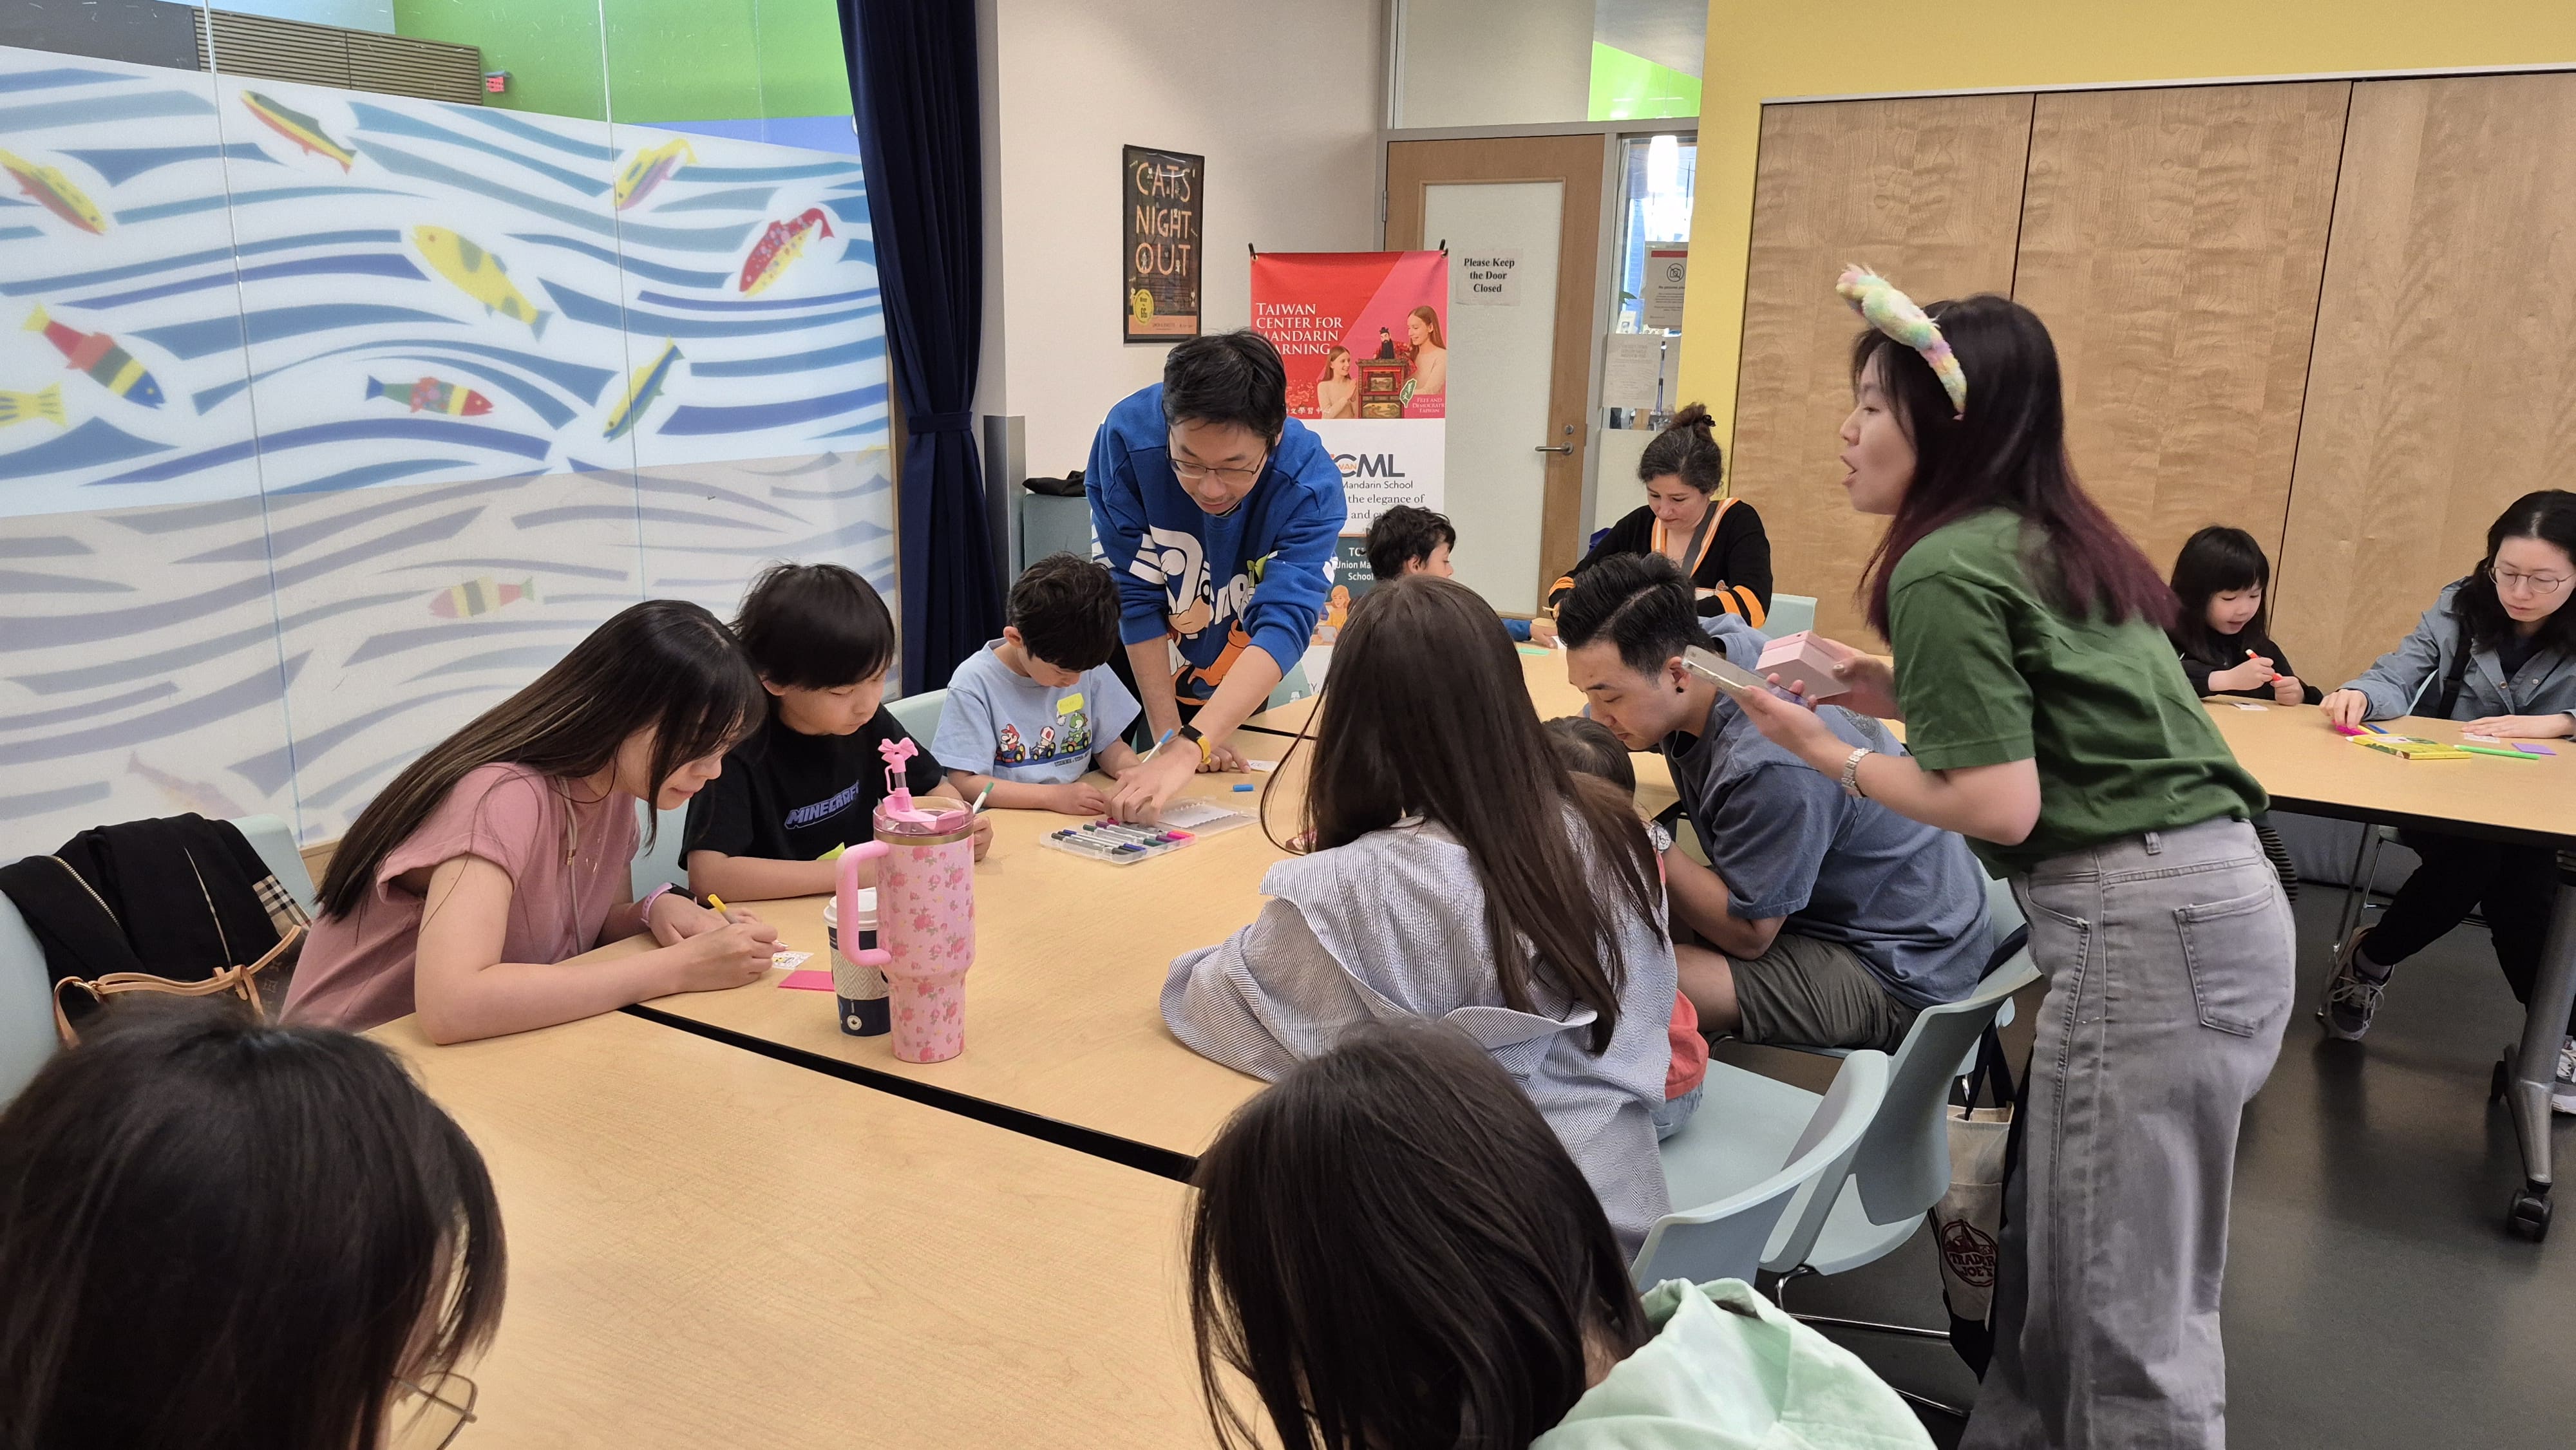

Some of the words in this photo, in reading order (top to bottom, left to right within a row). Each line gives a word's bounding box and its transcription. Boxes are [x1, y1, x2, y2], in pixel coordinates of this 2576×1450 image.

[1136, 162, 1196, 203] CATS'
[1136, 204, 1191, 239] NIGHT
[1135, 242, 1190, 276] OUT
[1464, 258, 1490, 267] Please
[1493, 258, 1515, 269] Keep
[1470, 270, 1483, 279] the
[1486, 271, 1507, 279] Door
[1473, 283, 1502, 292] Closed
[1256, 303, 1316, 315] TAIWAN
[1256, 317, 1312, 329] CENTER
[1316, 317, 1344, 328] FOR
[1273, 343, 1331, 355] ARNING
[1331, 453, 1406, 478] CML
[1384, 480, 1414, 489] School
[1348, 494, 1365, 504] the
[1367, 494, 1411, 505] elegance
[1414, 494, 1425, 504] of
[1350, 509, 1370, 519] and
[1347, 572, 1375, 581] School
